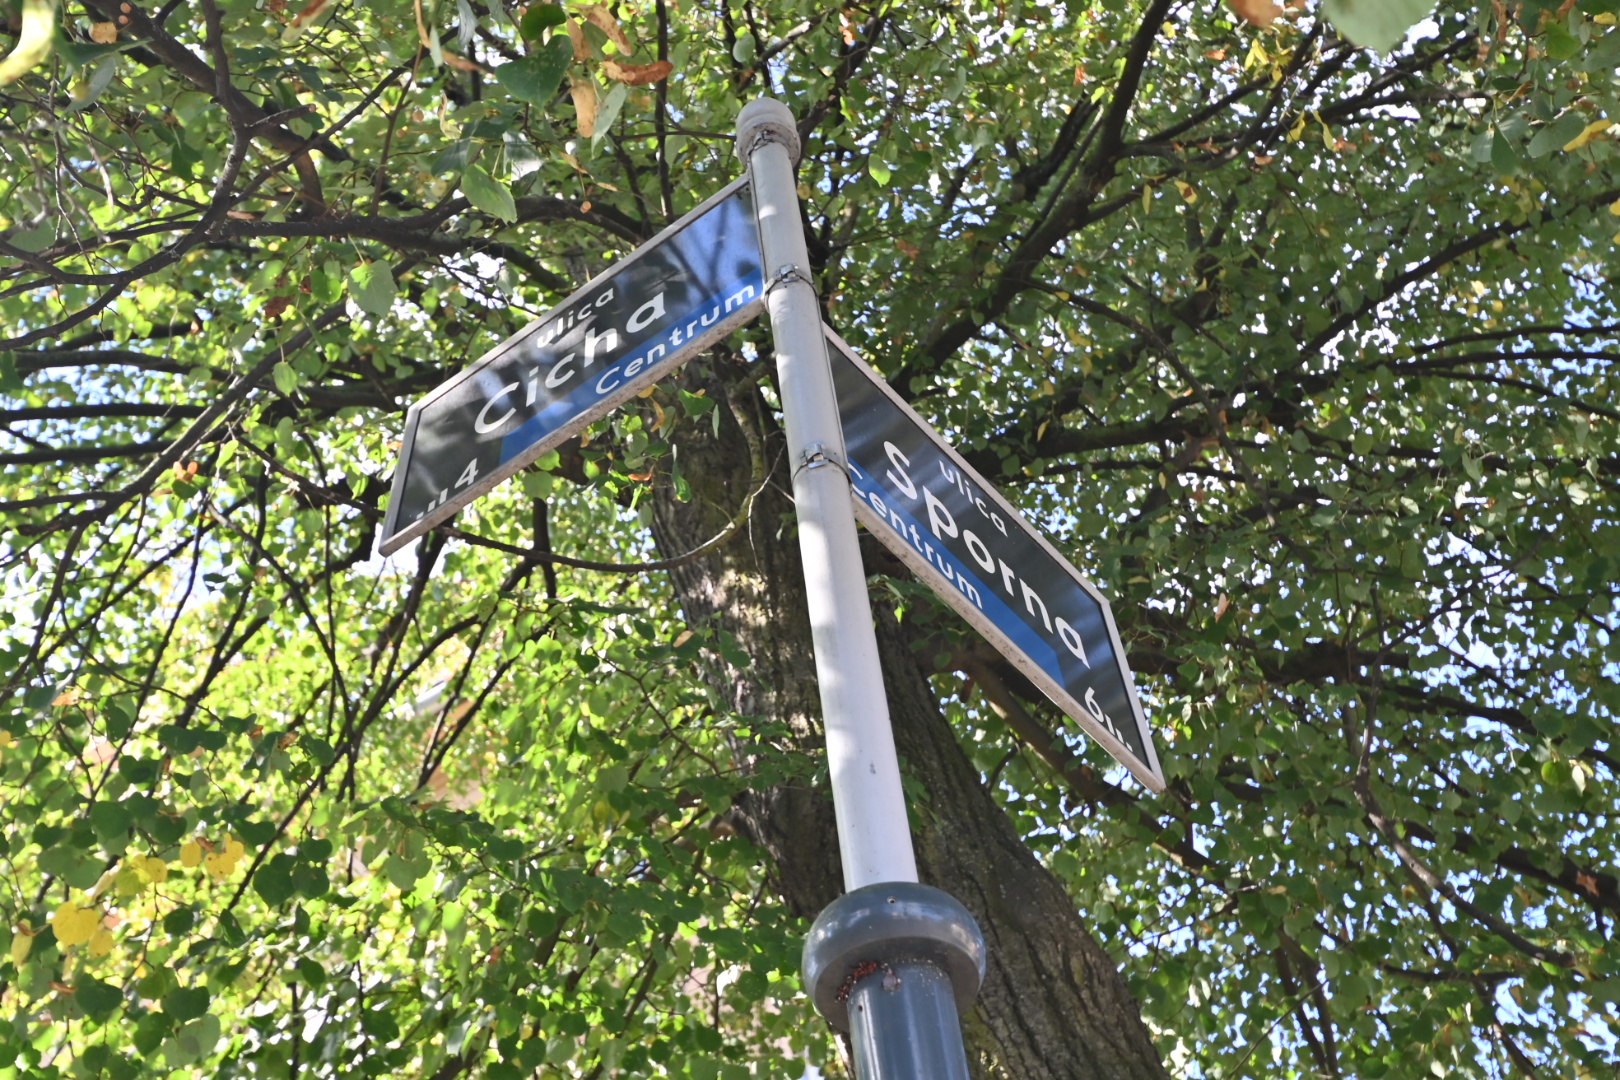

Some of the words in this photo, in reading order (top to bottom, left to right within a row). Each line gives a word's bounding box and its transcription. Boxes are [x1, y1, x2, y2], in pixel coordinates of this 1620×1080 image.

[474, 292, 666, 434] Cicha
[537, 287, 614, 348] ulica
[595, 284, 755, 395] Centrum
[939, 460, 1008, 537] ulica
[883, 441, 1091, 670] Sporna
